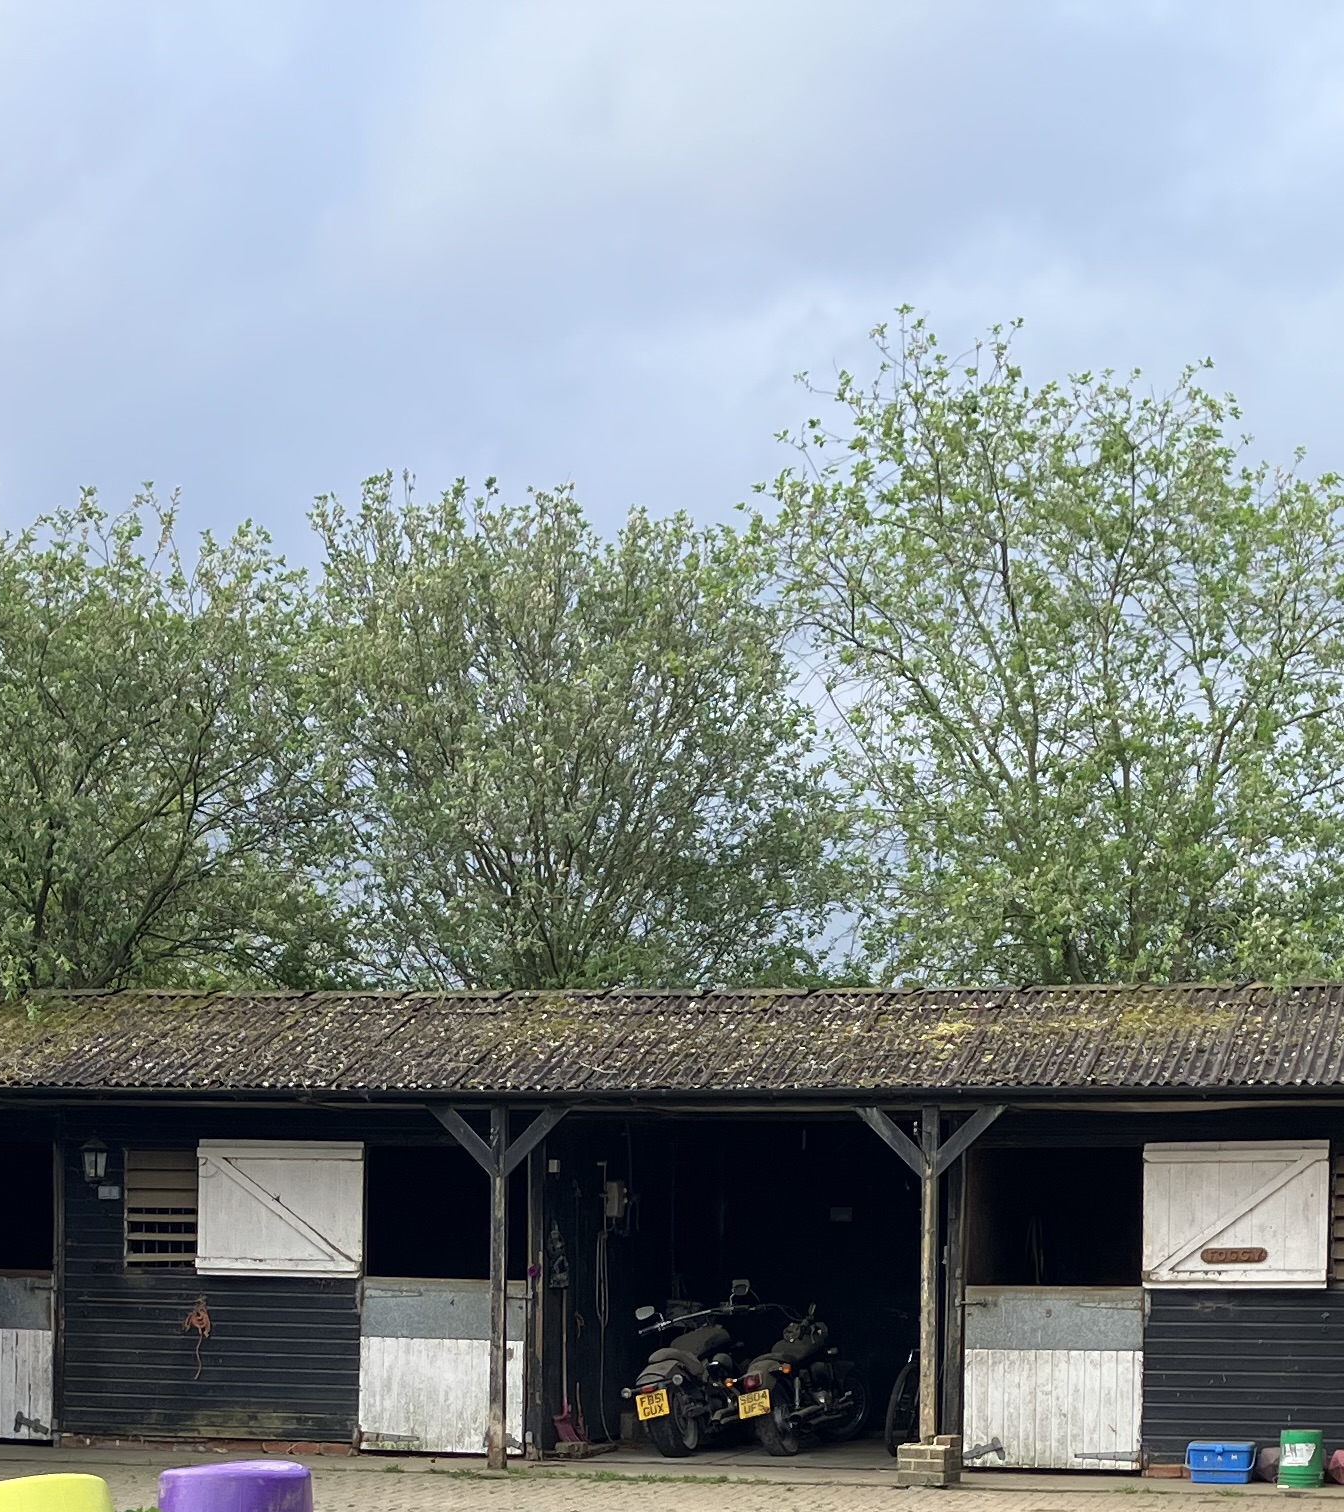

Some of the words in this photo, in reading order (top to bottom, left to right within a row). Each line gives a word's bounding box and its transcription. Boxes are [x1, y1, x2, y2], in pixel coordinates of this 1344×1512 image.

[1207, 1249, 1263, 1262] FOGGY
[643, 1403, 664, 1417] GUX
[743, 1401, 765, 1414] UFS
